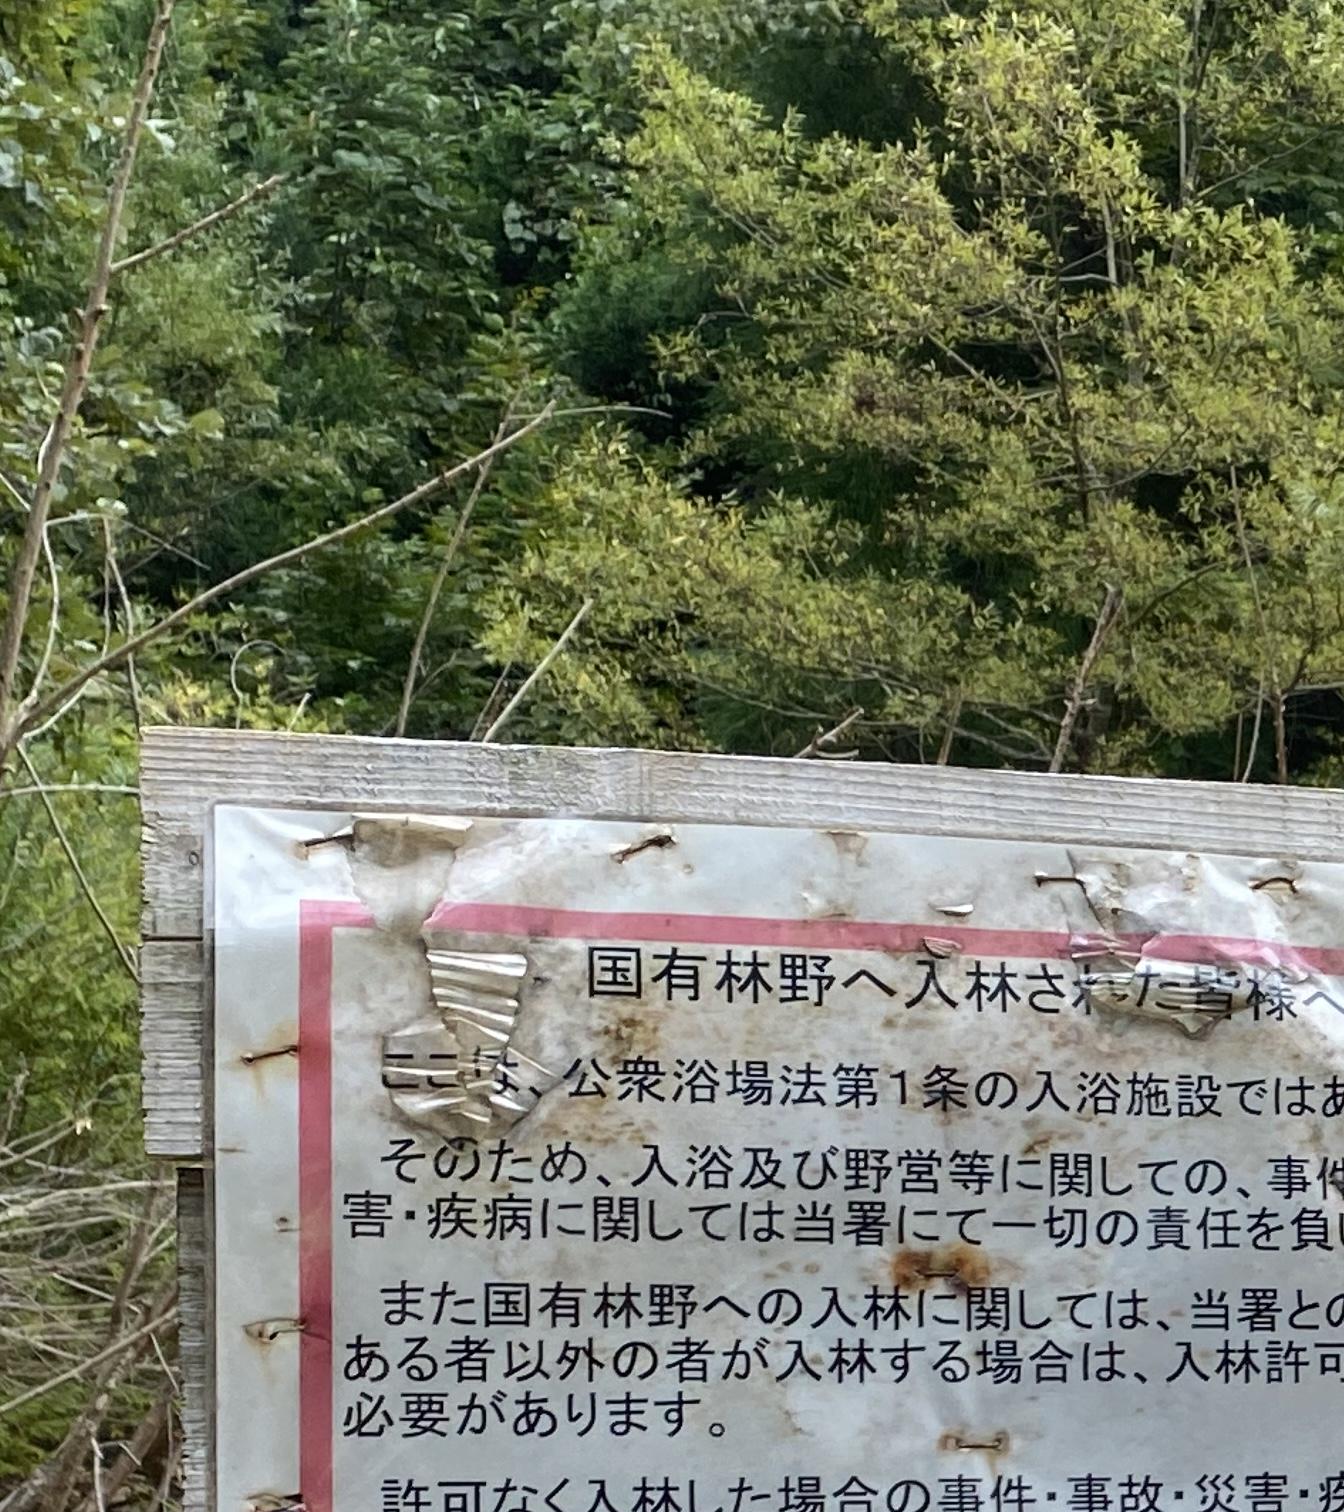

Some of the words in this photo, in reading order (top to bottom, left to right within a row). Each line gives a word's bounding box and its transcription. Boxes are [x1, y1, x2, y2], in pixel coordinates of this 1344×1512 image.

[342, 1391, 729, 1440] 必要があります。
